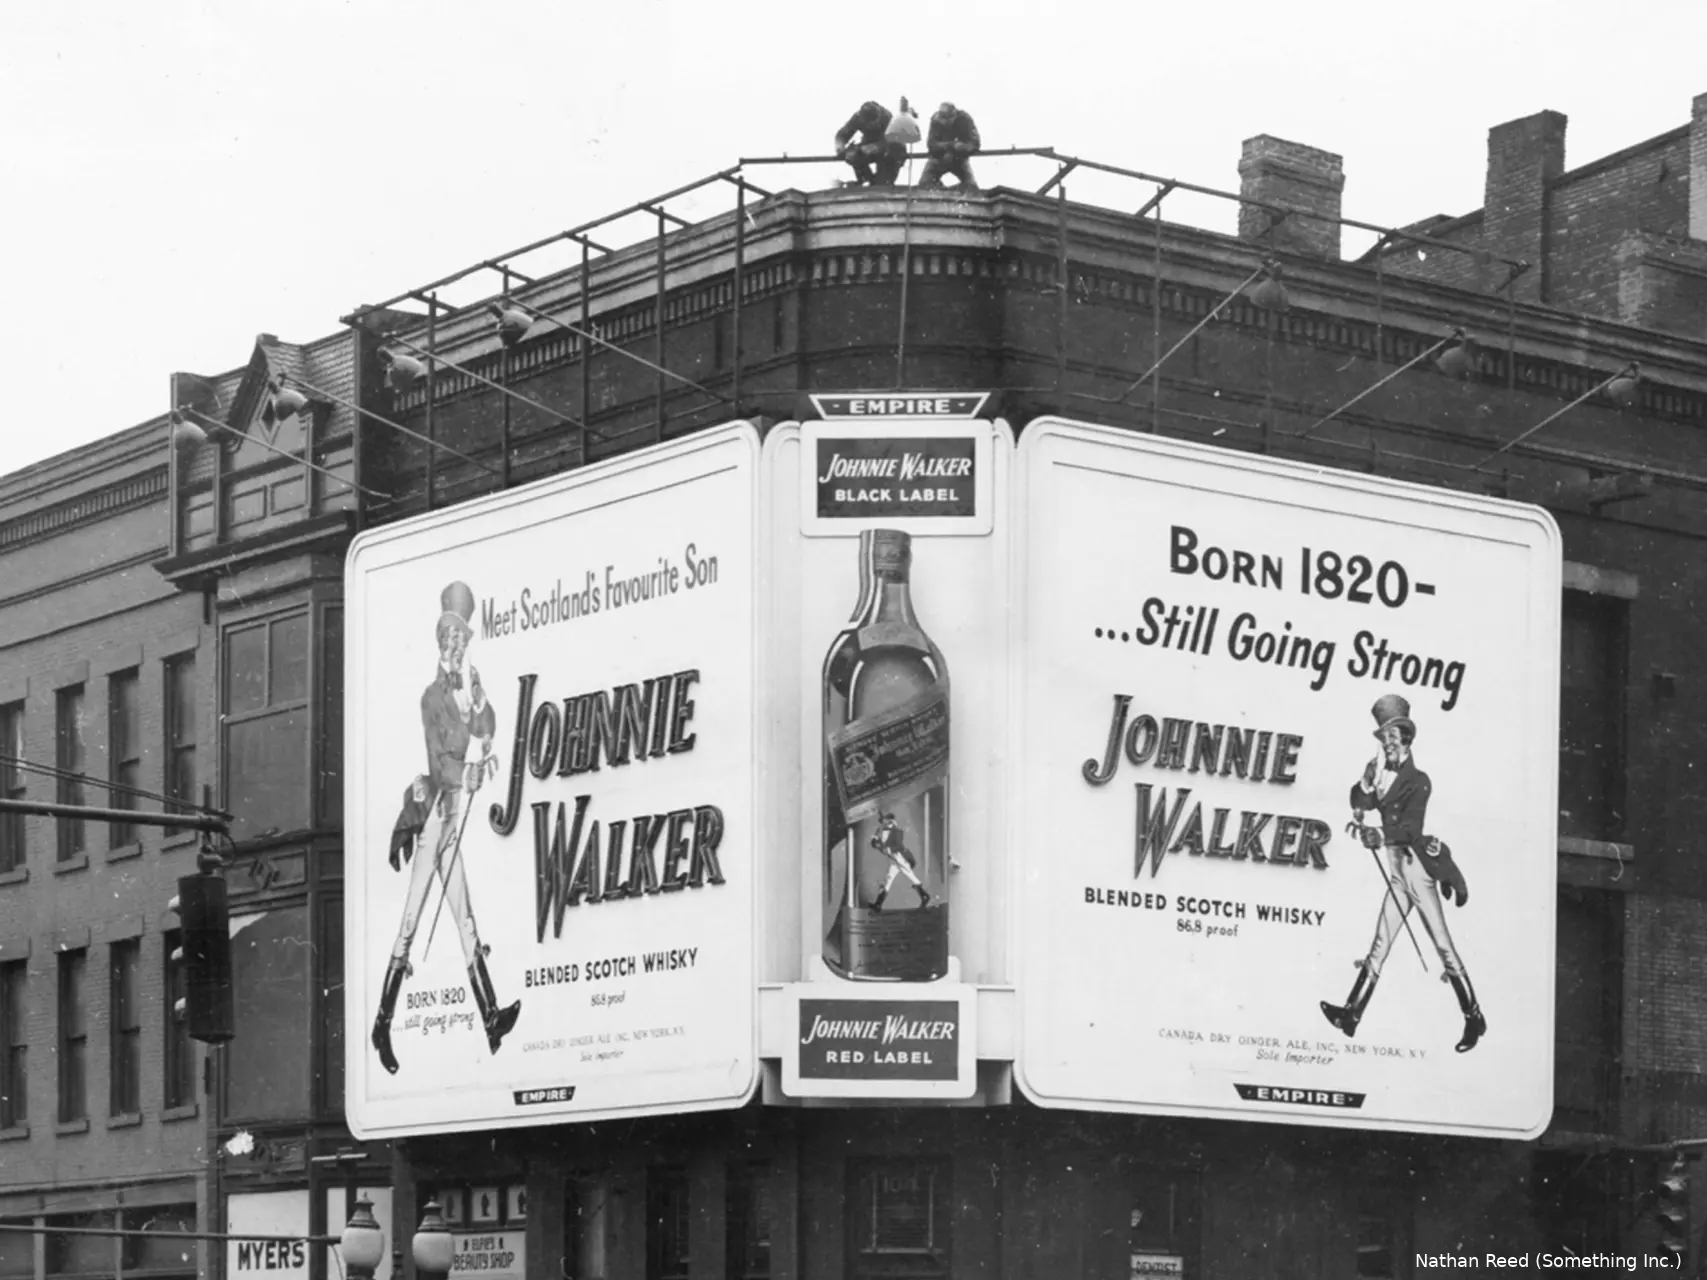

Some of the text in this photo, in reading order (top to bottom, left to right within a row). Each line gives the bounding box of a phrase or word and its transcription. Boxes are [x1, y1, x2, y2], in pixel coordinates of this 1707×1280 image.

[849, 399, 951, 415] EMPIRE
[818, 453, 972, 484] JOHNNIE WALKER
[834, 488, 959, 503] BLACK LABEL
[1169, 524, 1284, 591] BORN
[481, 542, 719, 641] Meet Scotland's Favourite Son
[1227, 612, 1336, 691] Going
[1347, 630, 1466, 712] Strong
[488, 668, 701, 837] JOHNNIE
[1081, 693, 1304, 787] JOHNNIE
[1133, 782, 1332, 880] WALKER
[530, 794, 726, 944] WALKER
[1084, 887, 1326, 927] BLENDED SCOTCH WHISKY
[1206, 924, 1239, 938] proof
[525, 947, 699, 989] BLENDED SCOTCH WHISKY
[406, 986, 466, 1010] BORN 1820
[422, 1011, 447, 1036] going
[448, 1011, 475, 1031] strong
[800, 1014, 956, 1046] JOHNNIE WALKER
[1158, 1027, 1204, 1042] CANADA
[1209, 1032, 1232, 1044] DRY
[1238, 1035, 1281, 1049] GINGER
[1344, 1043, 1367, 1055] NEW
[825, 1050, 933, 1065] RED LABEL
[1255, 1048, 1334, 1066] Sole Importer
[520, 1087, 568, 1104] EMPIRE
[1256, 1086, 1346, 1106] EMPIRE
[237, 1241, 305, 1271] MYERS
[453, 1250, 516, 1271] BEAUTY SHOP
